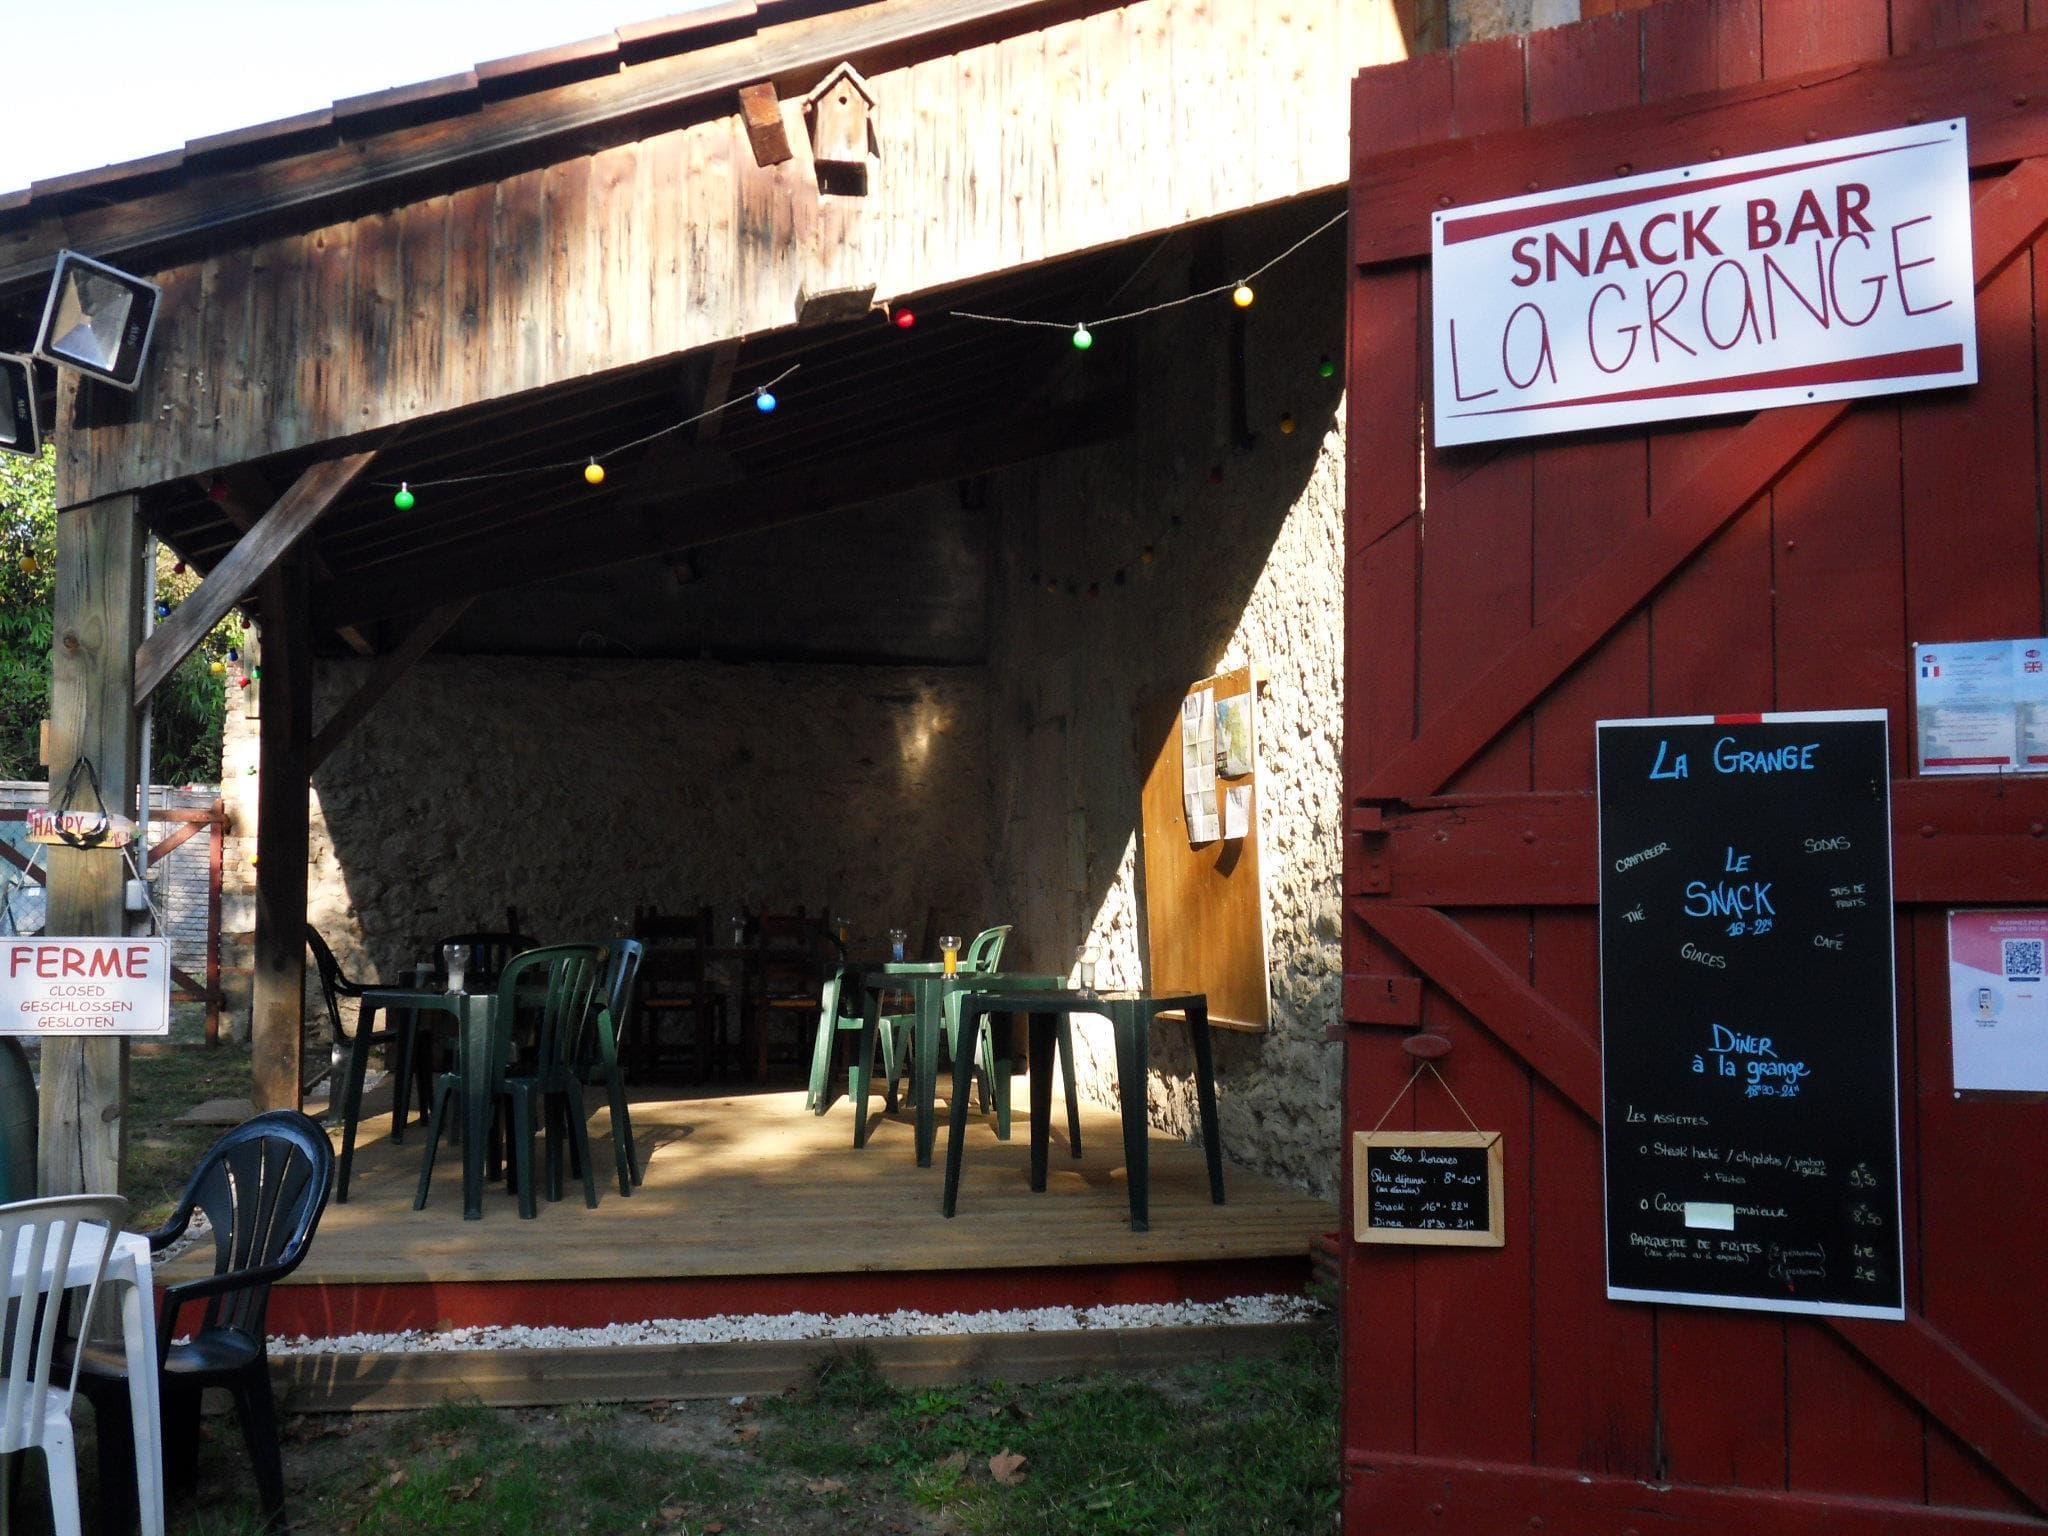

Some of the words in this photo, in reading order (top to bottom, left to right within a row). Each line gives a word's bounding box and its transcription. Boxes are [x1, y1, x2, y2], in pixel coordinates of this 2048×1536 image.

[1510, 204, 1723, 287] SNACK
[1747, 182, 1876, 251] BAR
[1713, 736, 1820, 774] GRANGE
[1804, 836, 1851, 853] SODAS
[1725, 846, 1751, 872] LE
[1684, 880, 1776, 919] SNACK
[10, 946, 150, 978] FERME
[49, 985, 105, 997] CLOSED
[20, 1000, 133, 1013] GESCHLOSSEN
[38, 1016, 115, 1028] GESLOTEN
[1719, 1055, 1736, 1077] la
[1390, 1148, 1413, 1163] Les
[1418, 1149, 1458, 1164] horaires
[1654, 1142, 1688, 1157] Steak
[1374, 1201, 1405, 1211] Snack
